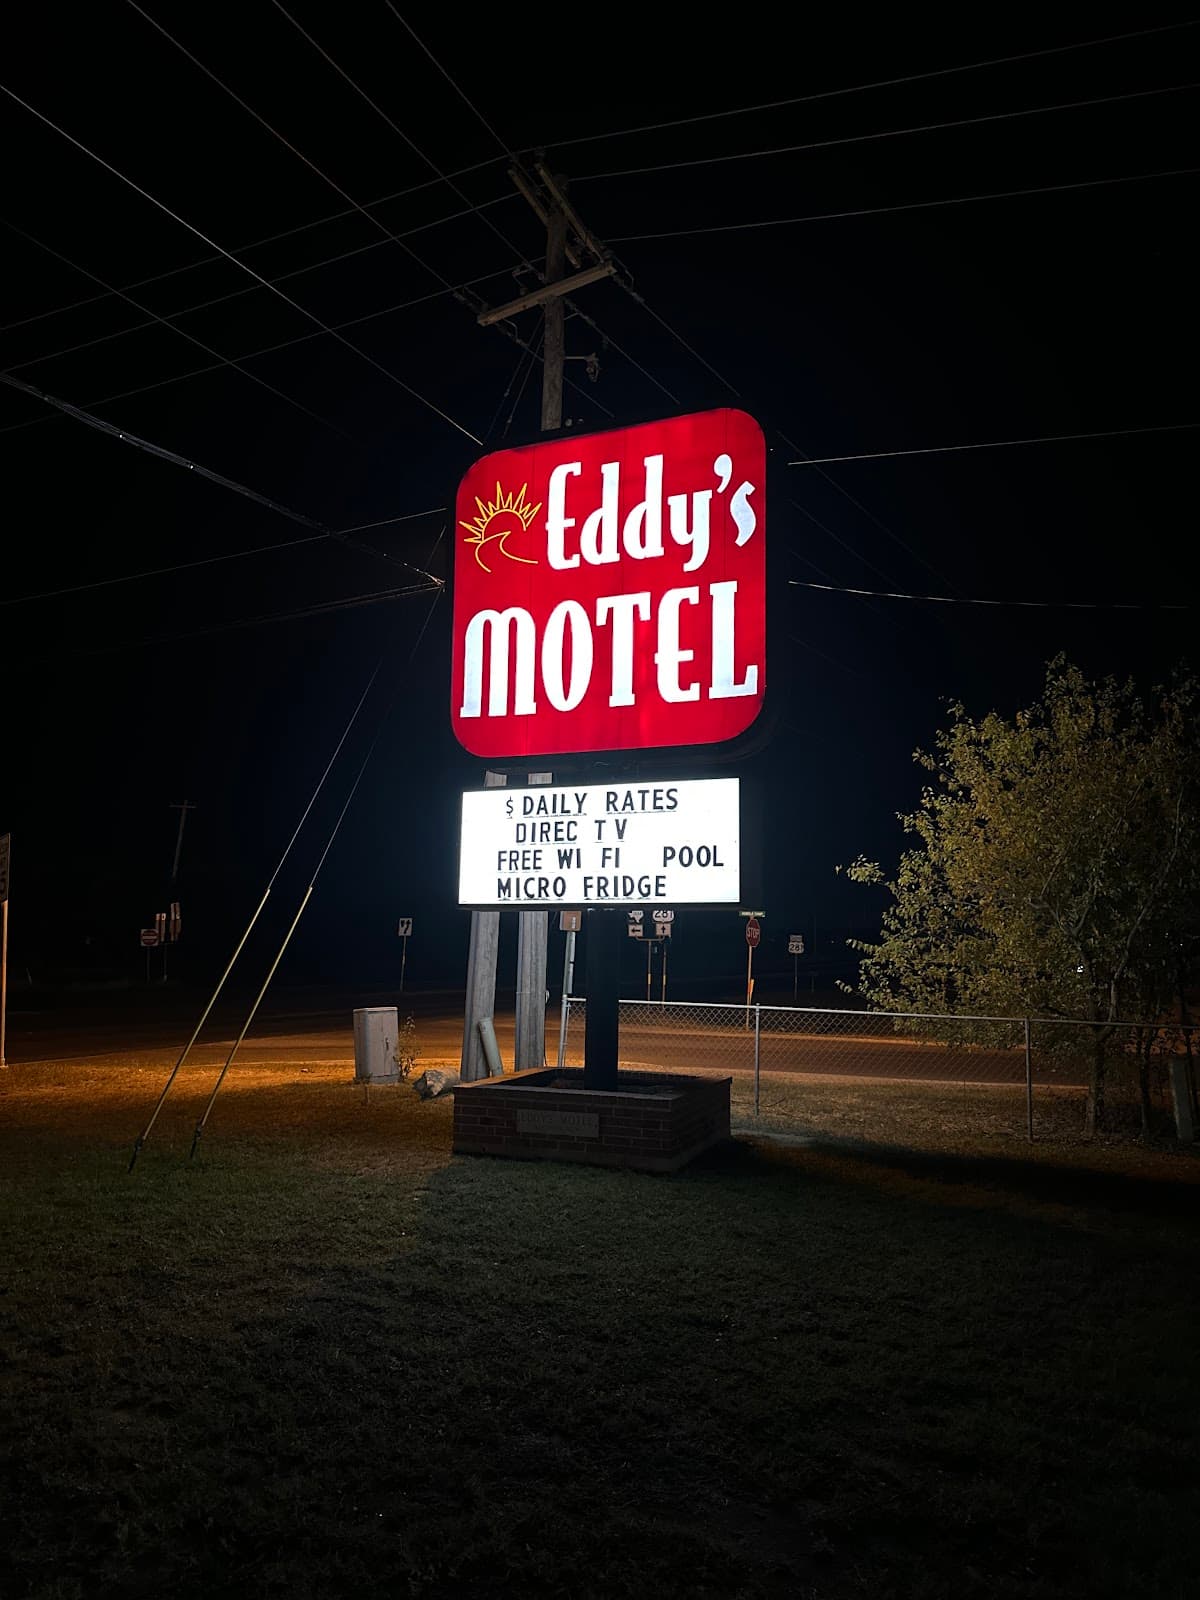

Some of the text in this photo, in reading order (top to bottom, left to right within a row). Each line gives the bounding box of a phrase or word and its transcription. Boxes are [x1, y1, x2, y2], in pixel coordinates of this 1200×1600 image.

[545, 454, 757, 572] Eddy's
[459, 580, 759, 719] MOTEL
[505, 788, 679, 816] $ DAILY RATES
[515, 820, 578, 843] DIREC
[497, 845, 725, 871] FREE WI FI POOL
[497, 875, 667, 898] MICRO FRIDGE
[747, 927, 760, 939] STOP
